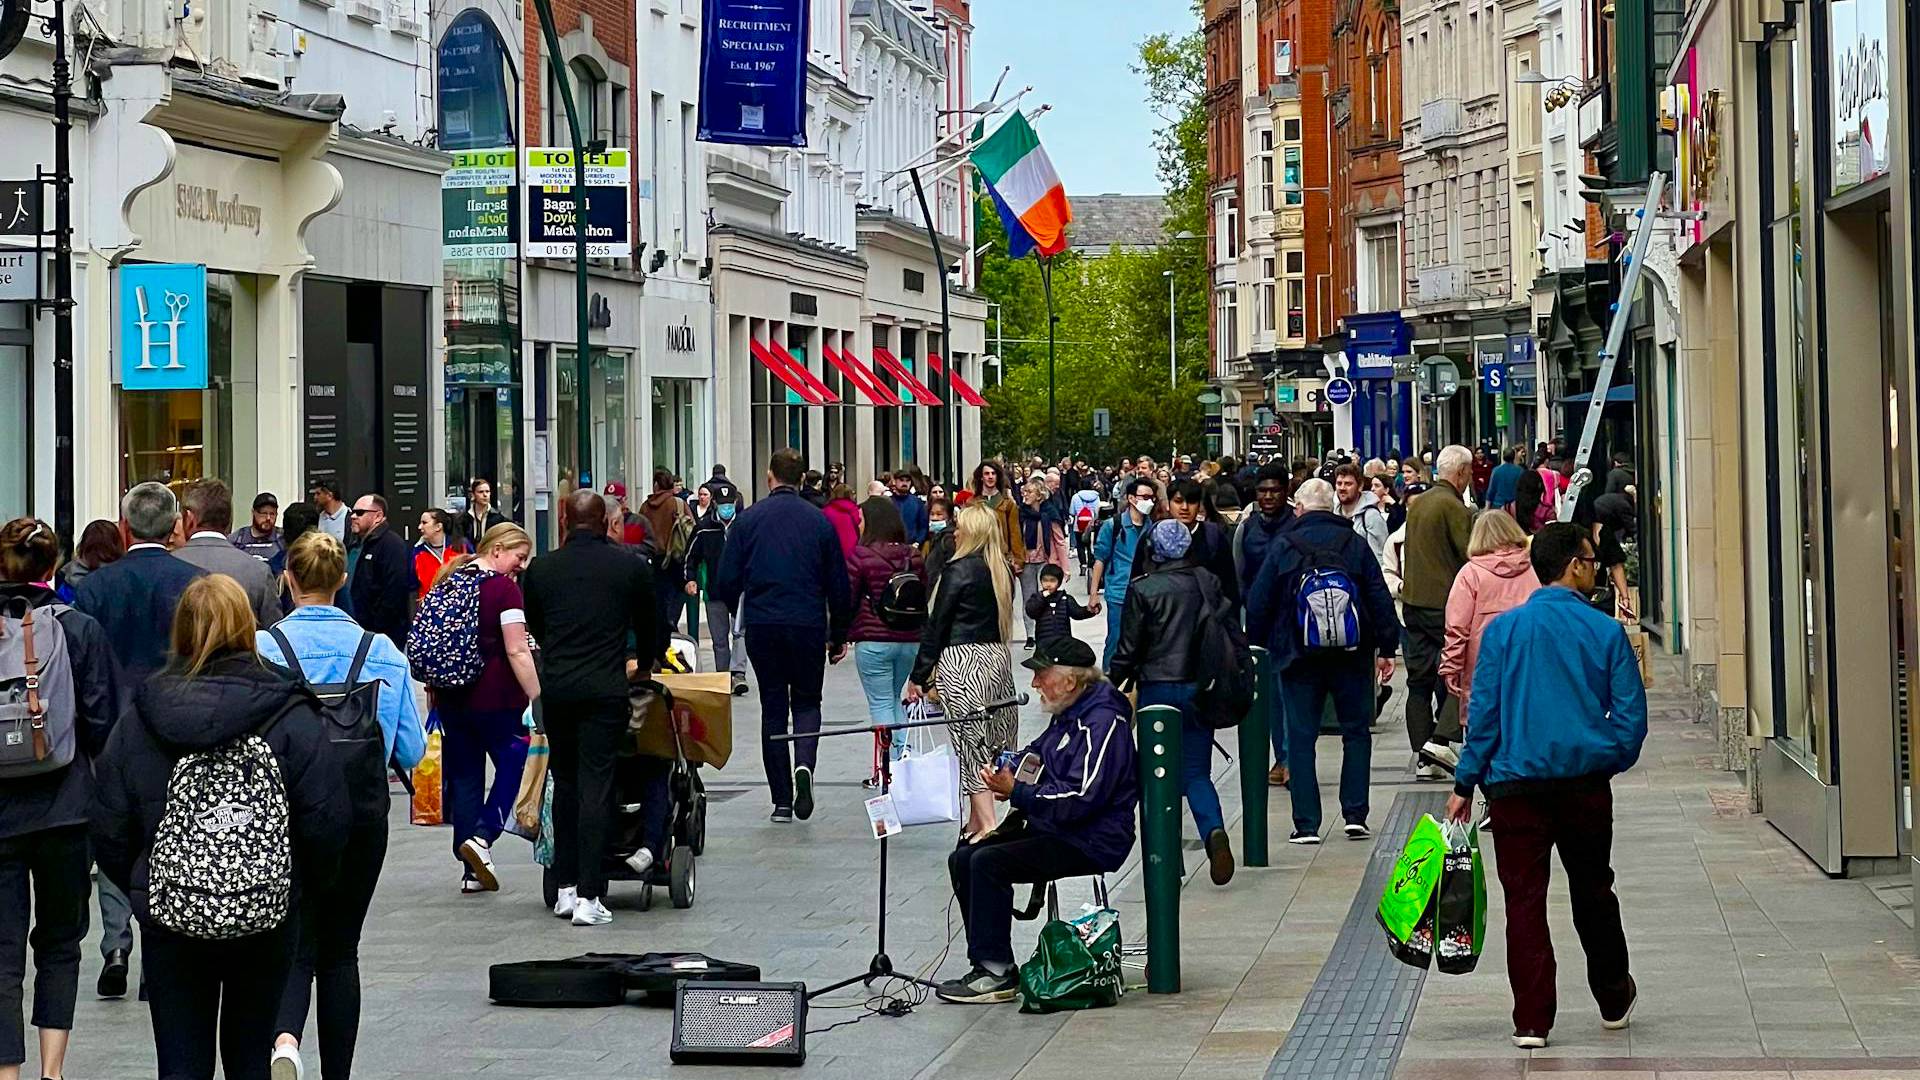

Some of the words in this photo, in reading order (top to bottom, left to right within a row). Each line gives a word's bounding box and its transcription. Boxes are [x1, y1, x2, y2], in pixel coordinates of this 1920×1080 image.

[719, 19, 792, 32] RECRUITMENT
[721, 39, 785, 52] SPECIALISTS
[730, 61, 752, 71] Estd.
[754, 61, 776, 71] 1967
[544, 153, 570, 165] TO
[543, 198, 590, 212] Bagnl
[543, 212, 577, 225] Doyle
[543, 224, 613, 236] Machon
[562, 246, 577, 254] 67
[134, 320, 187, 368] H
[1490, 369, 1500, 387] S
[720, 996, 758, 1004] CUBE
